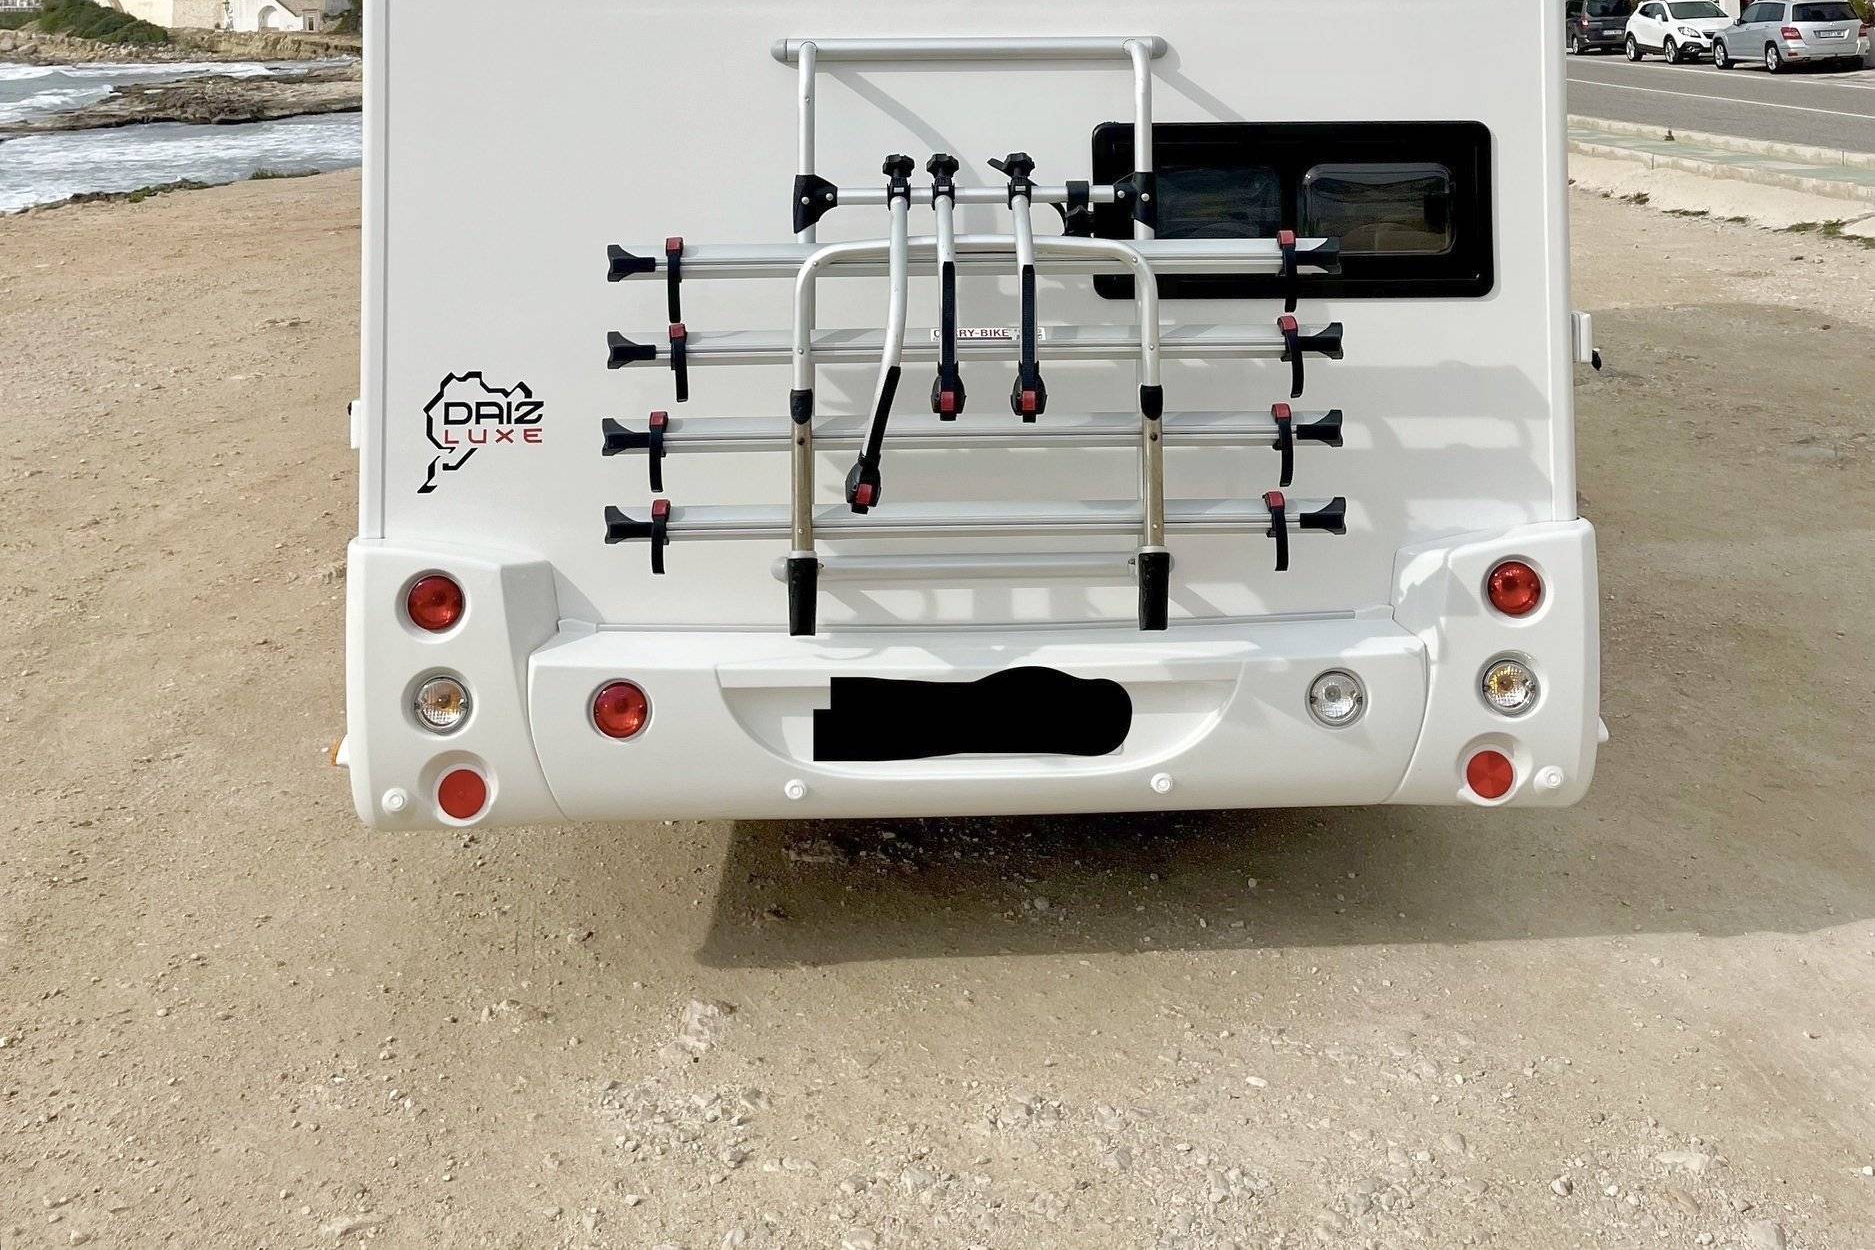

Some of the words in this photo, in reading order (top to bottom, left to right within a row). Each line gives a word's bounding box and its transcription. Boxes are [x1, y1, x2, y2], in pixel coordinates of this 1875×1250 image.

[933, 329, 1009, 338] CRY-BIKE
[443, 401, 545, 425] DAIZ
[444, 428, 543, 444] LUXE
